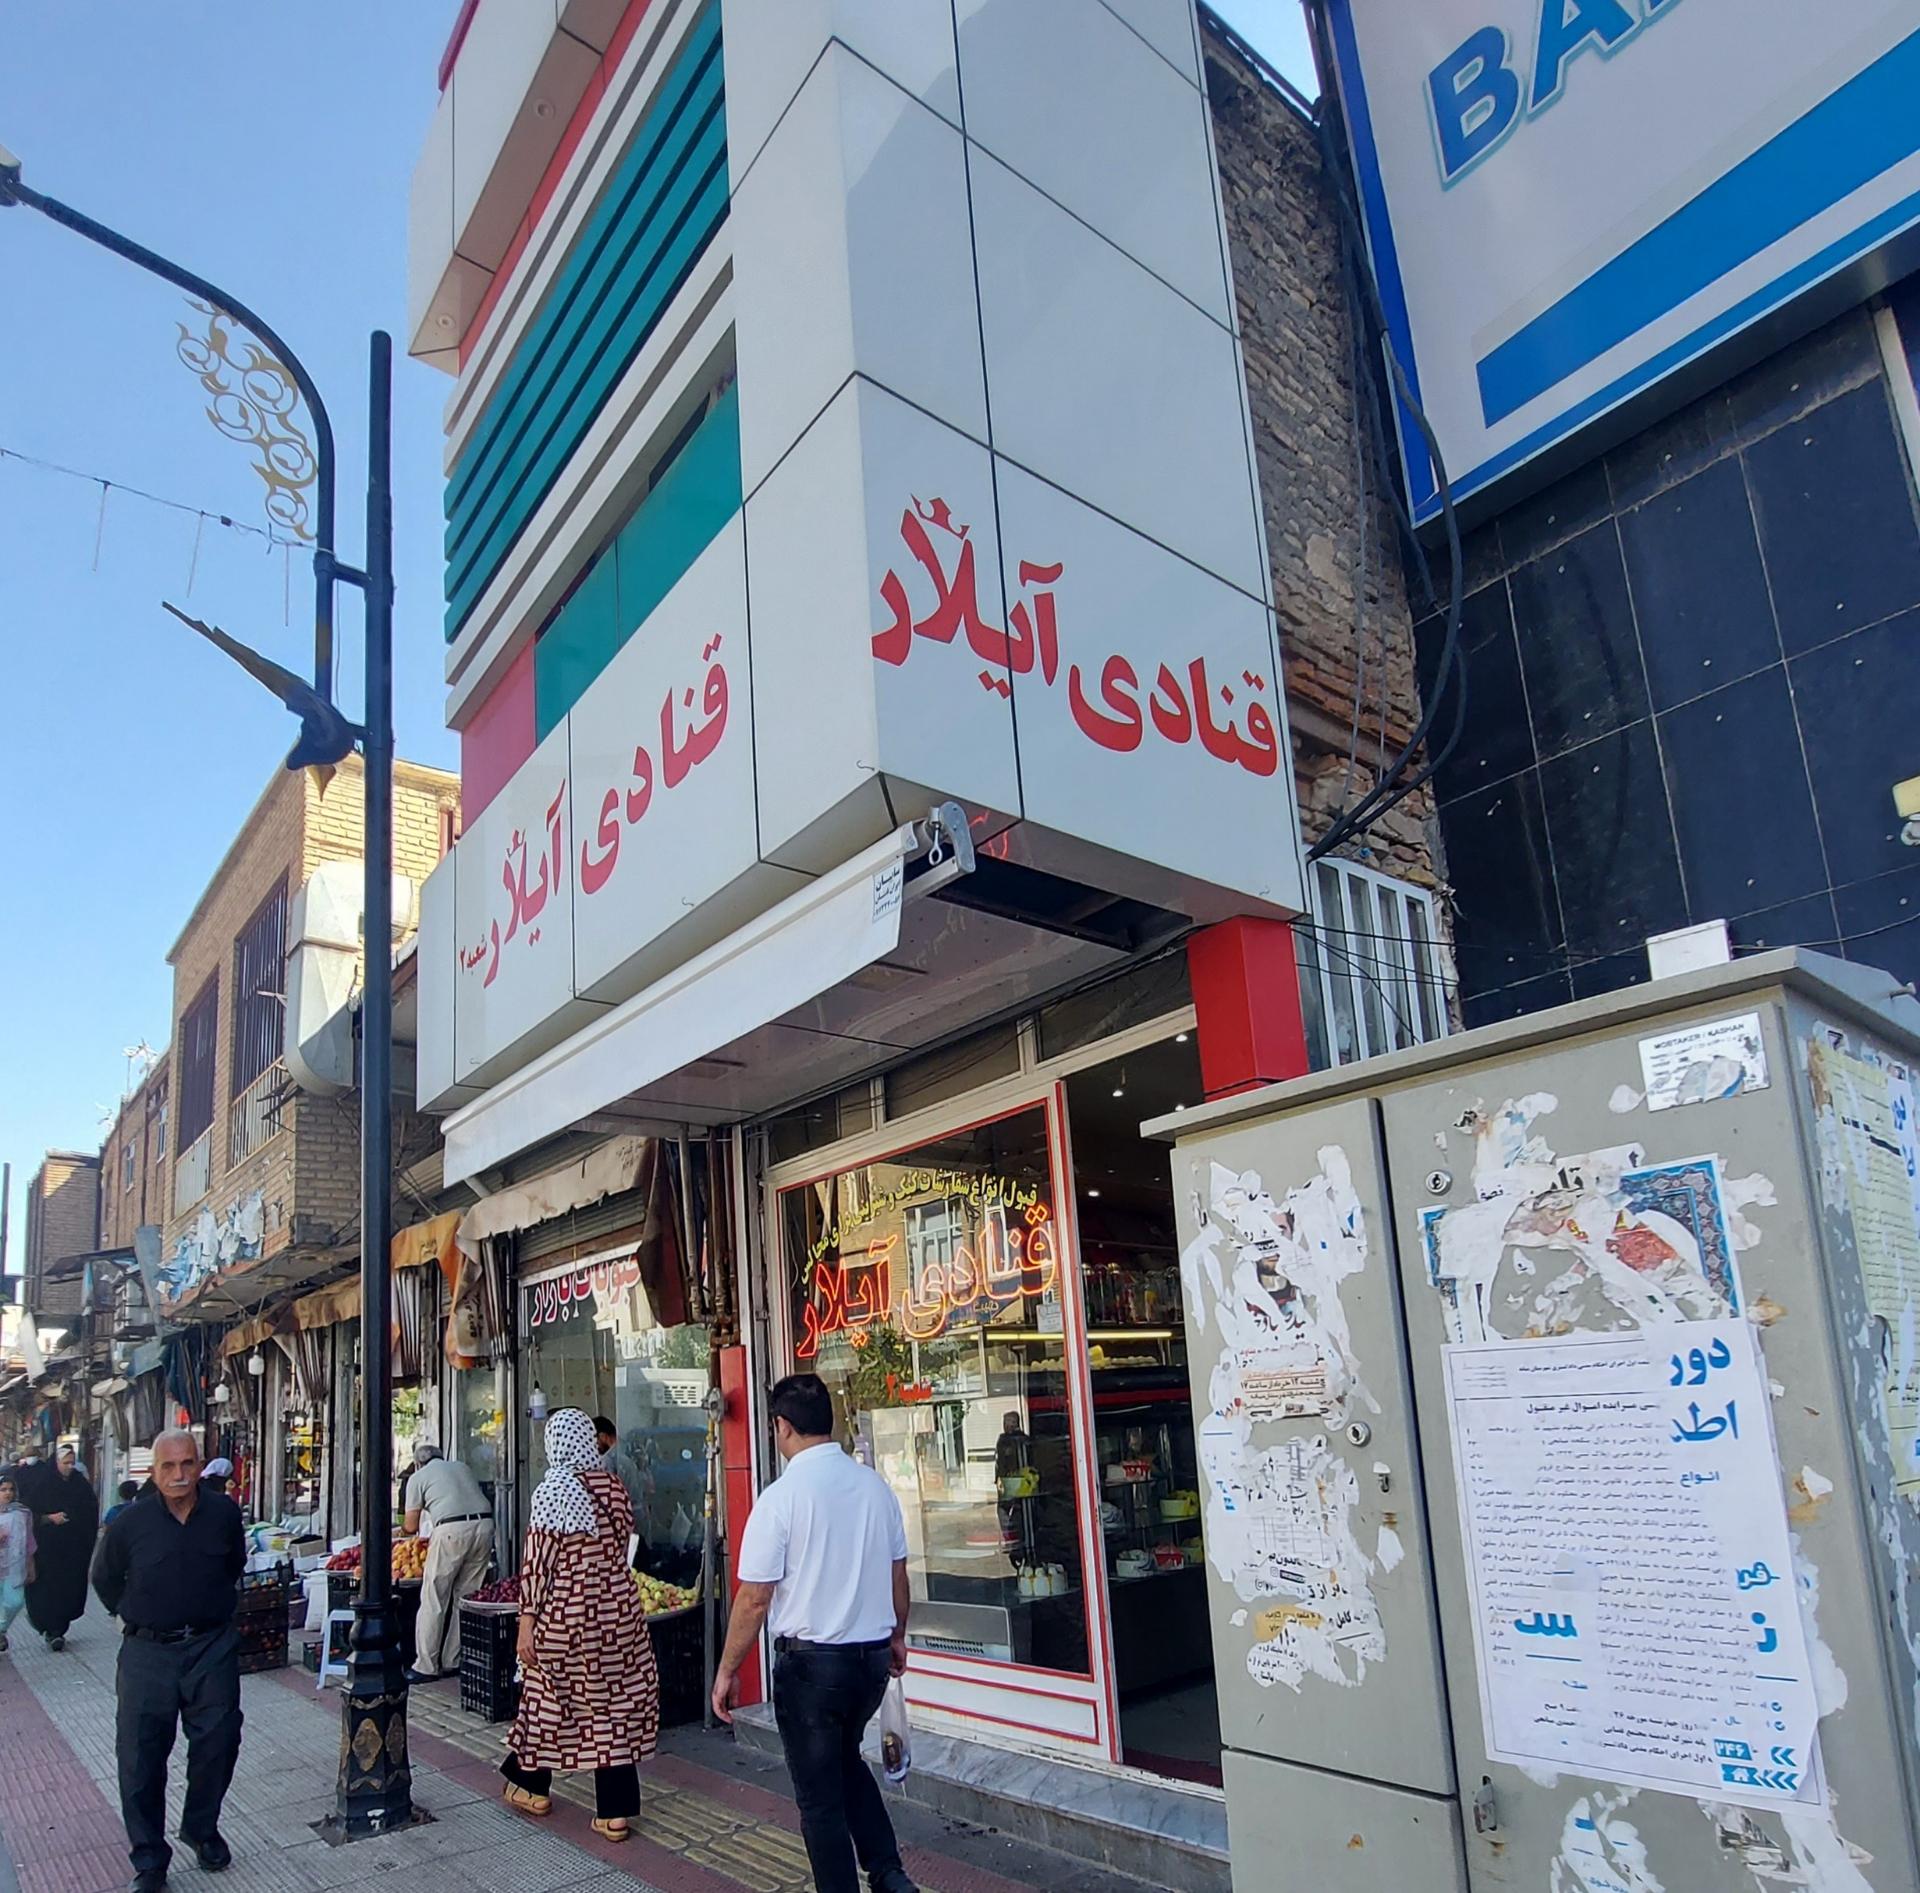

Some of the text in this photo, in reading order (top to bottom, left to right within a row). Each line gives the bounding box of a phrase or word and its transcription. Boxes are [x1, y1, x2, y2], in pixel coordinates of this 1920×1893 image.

[871, 494, 1278, 776] قنادی آیلار
[581, 634, 730, 894] قنادی
[483, 778, 566, 987] آیلار
[895, 1170, 919, 1201] کیک
[921, 1168, 970, 1199] سفارشات
[969, 1173, 1005, 1206] انواع
[1004, 1182, 1037, 1210] قبول
[886, 1193, 895, 1211] و
[796, 1203, 1060, 1359] قنادی آیلار
